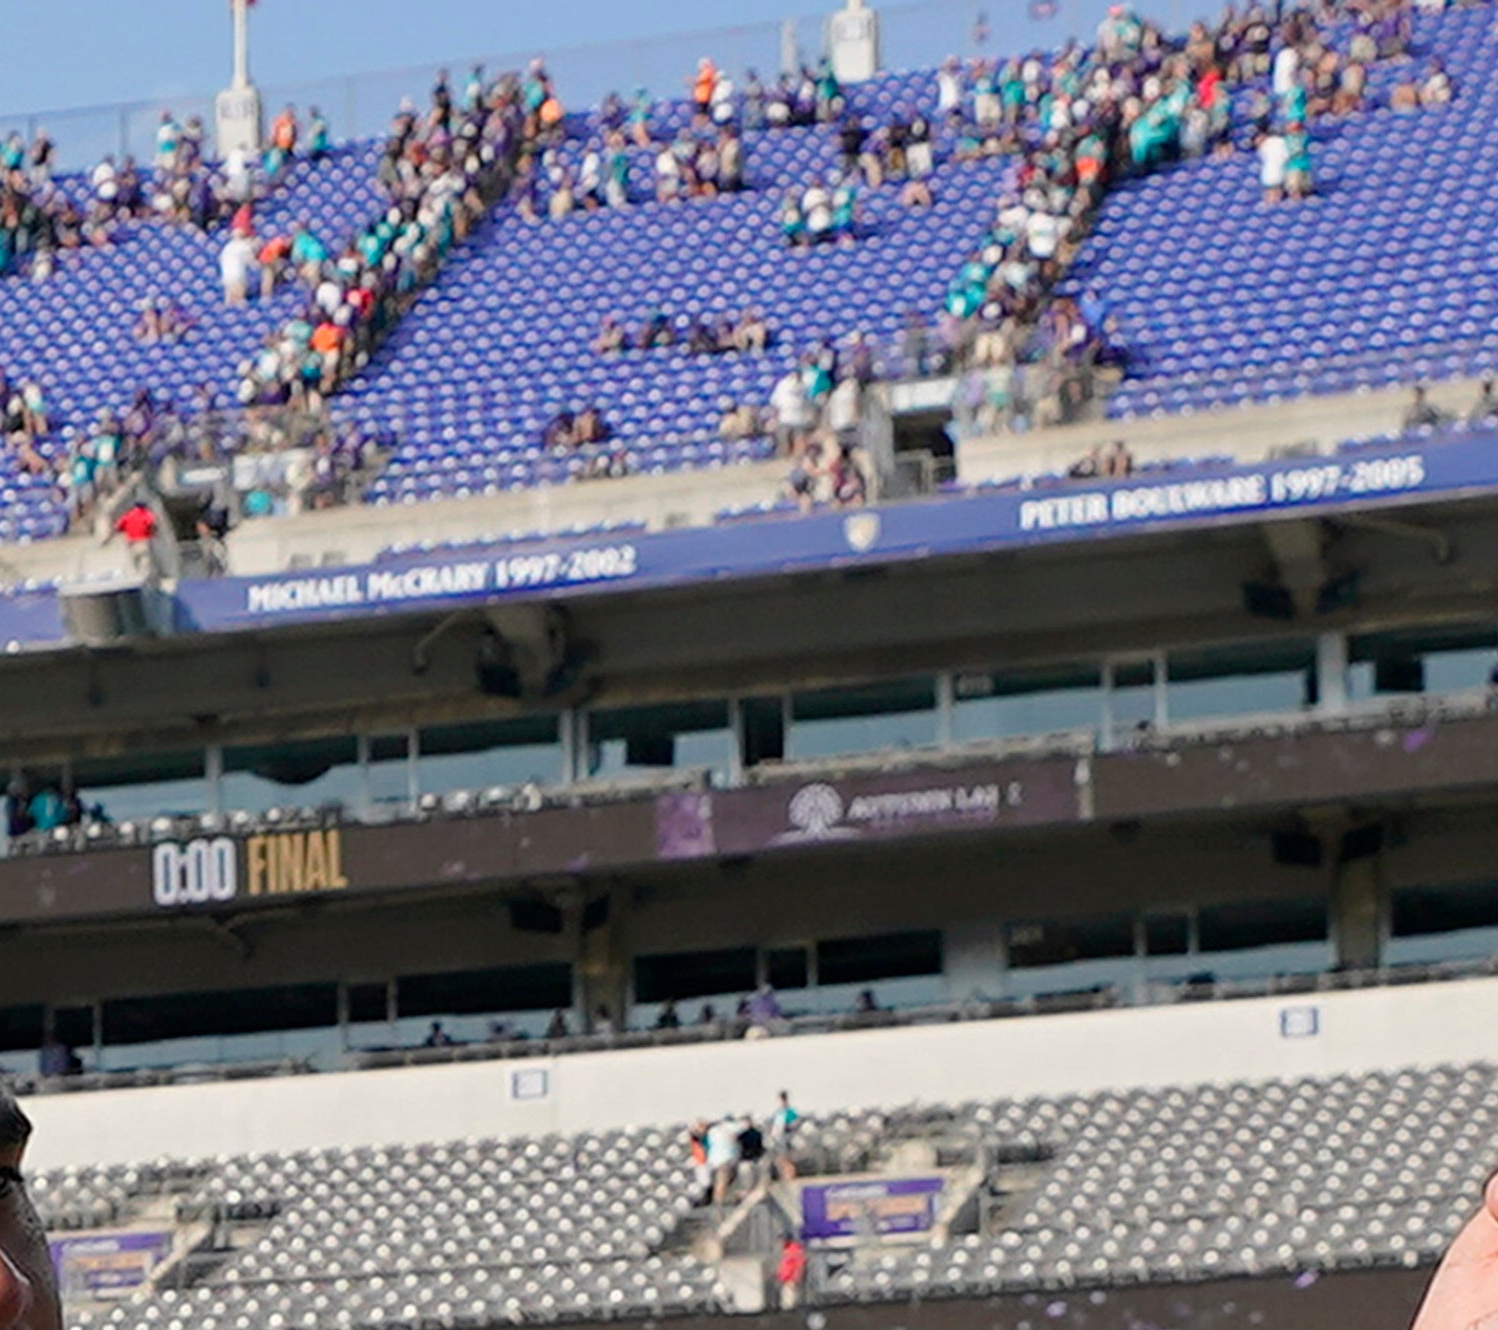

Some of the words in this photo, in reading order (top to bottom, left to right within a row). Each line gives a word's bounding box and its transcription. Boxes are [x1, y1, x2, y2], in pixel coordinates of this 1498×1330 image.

[1020, 493, 1108, 530] PETER
[1112, 474, 1266, 520] BOULWARE
[248, 577, 362, 612] MICHAEL
[367, 560, 489, 600] McCRARY
[495, 544, 637, 588] 1997-2002
[154, 837, 238, 906] 0:00
[246, 829, 349, 896] FINAL
